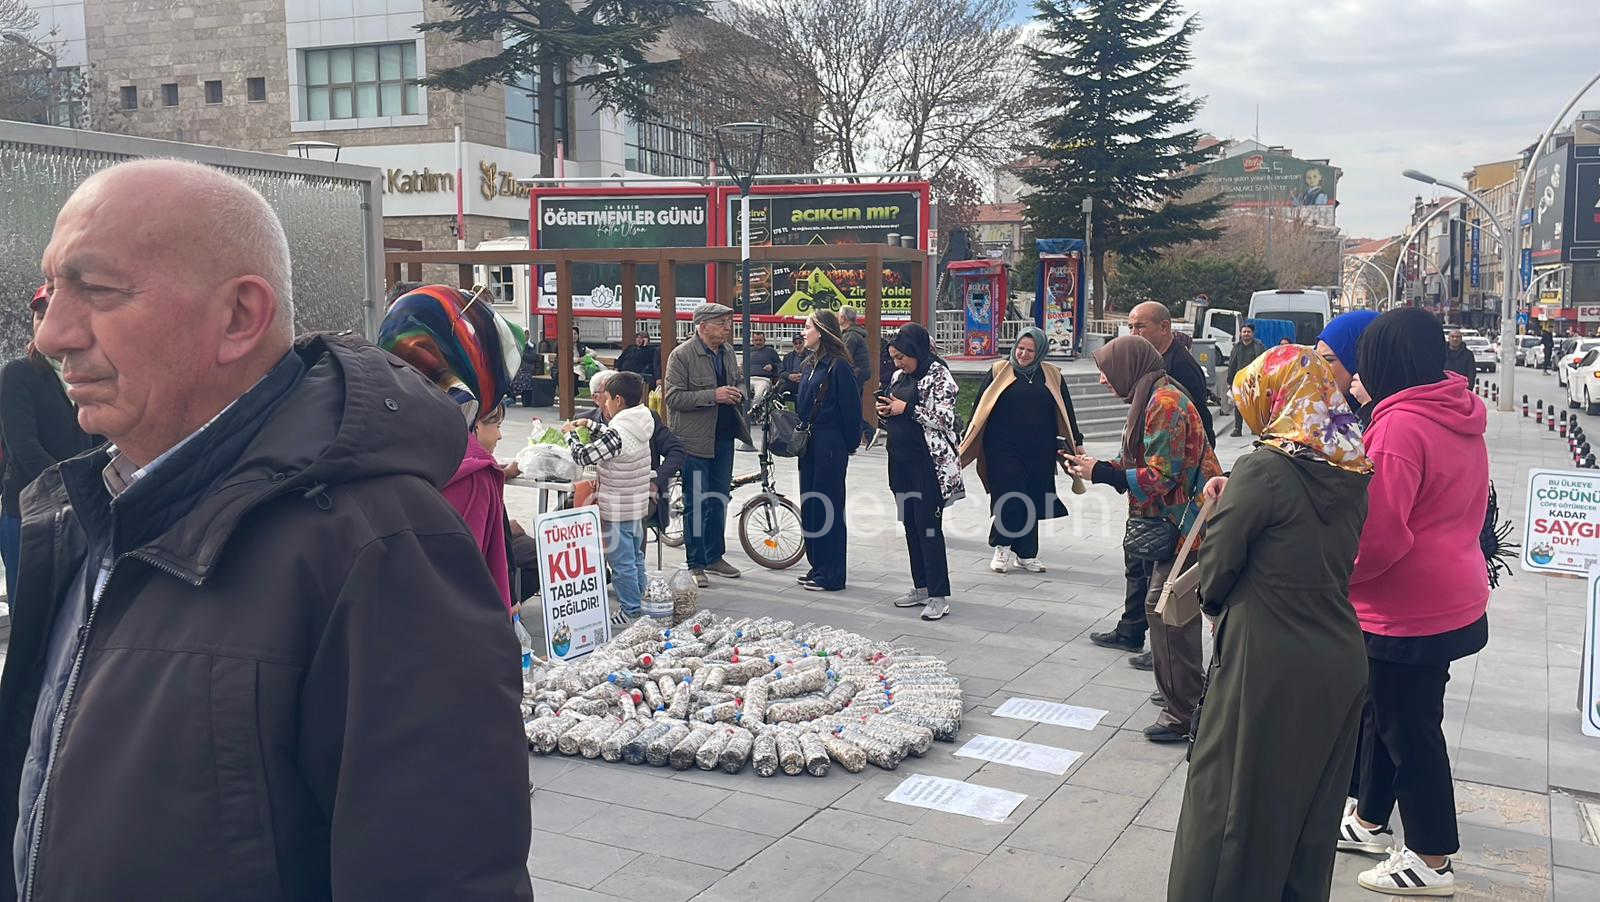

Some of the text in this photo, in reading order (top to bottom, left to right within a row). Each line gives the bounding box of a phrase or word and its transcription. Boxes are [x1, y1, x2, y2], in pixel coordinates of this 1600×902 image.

[387, 167, 455, 194] Katılım
[543, 205, 705, 226] ÖĞRETMENLER GÜNÜ
[1561, 479, 1593, 489] ÜLKEYE
[1549, 510, 1587, 519] KADAR
[545, 521, 593, 545] TÜRKİYE
[1534, 518, 1600, 539] SAYGI
[1552, 536, 1580, 546] DUY!
[547, 542, 597, 584] KÜL
[550, 576, 599, 601] TABLASI
